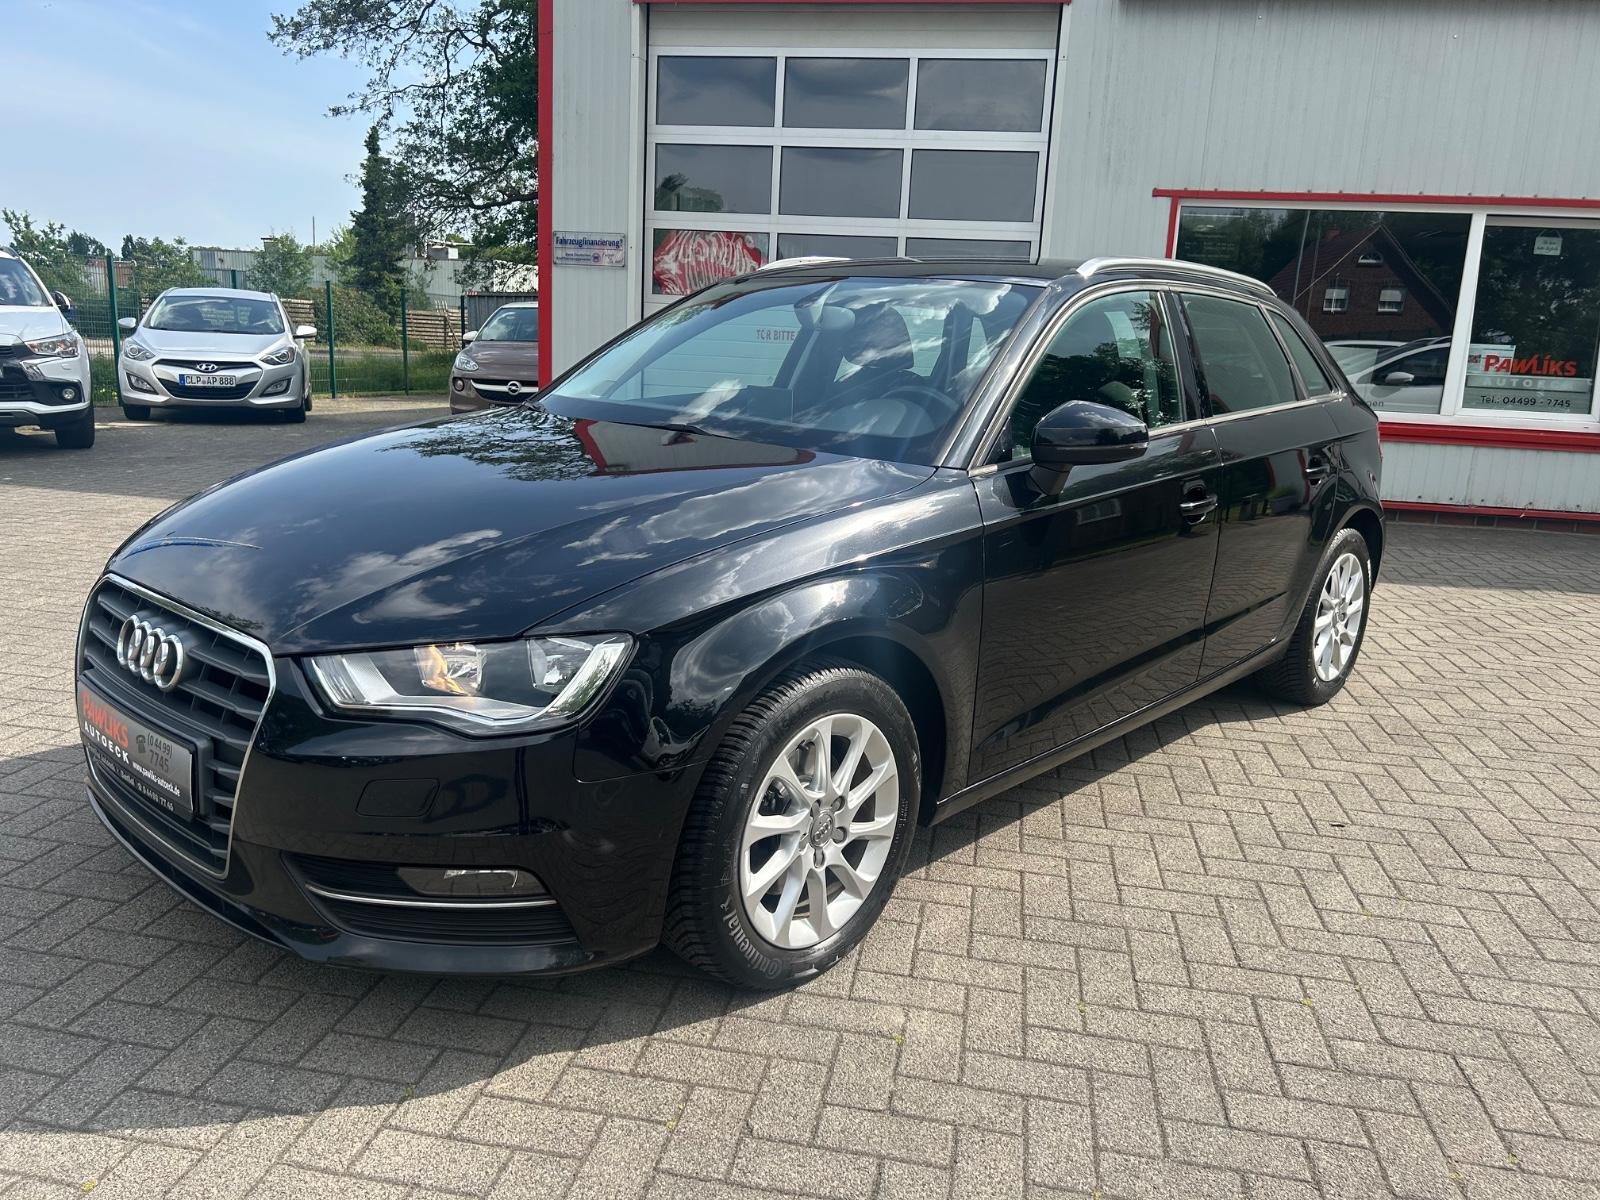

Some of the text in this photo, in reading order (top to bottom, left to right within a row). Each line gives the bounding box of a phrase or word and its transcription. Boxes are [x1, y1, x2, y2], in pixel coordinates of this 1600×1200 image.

[774, 330, 796, 341] BITTE
[185, 375, 234, 386] CLP AP 888
[1481, 395, 1500, 404] Tel.:
[1503, 396, 1537, 406] 04499
[1547, 398, 1571, 408] 7745
[84, 720, 130, 765] AUTOECK
[723, 909, 783, 979] Continental
